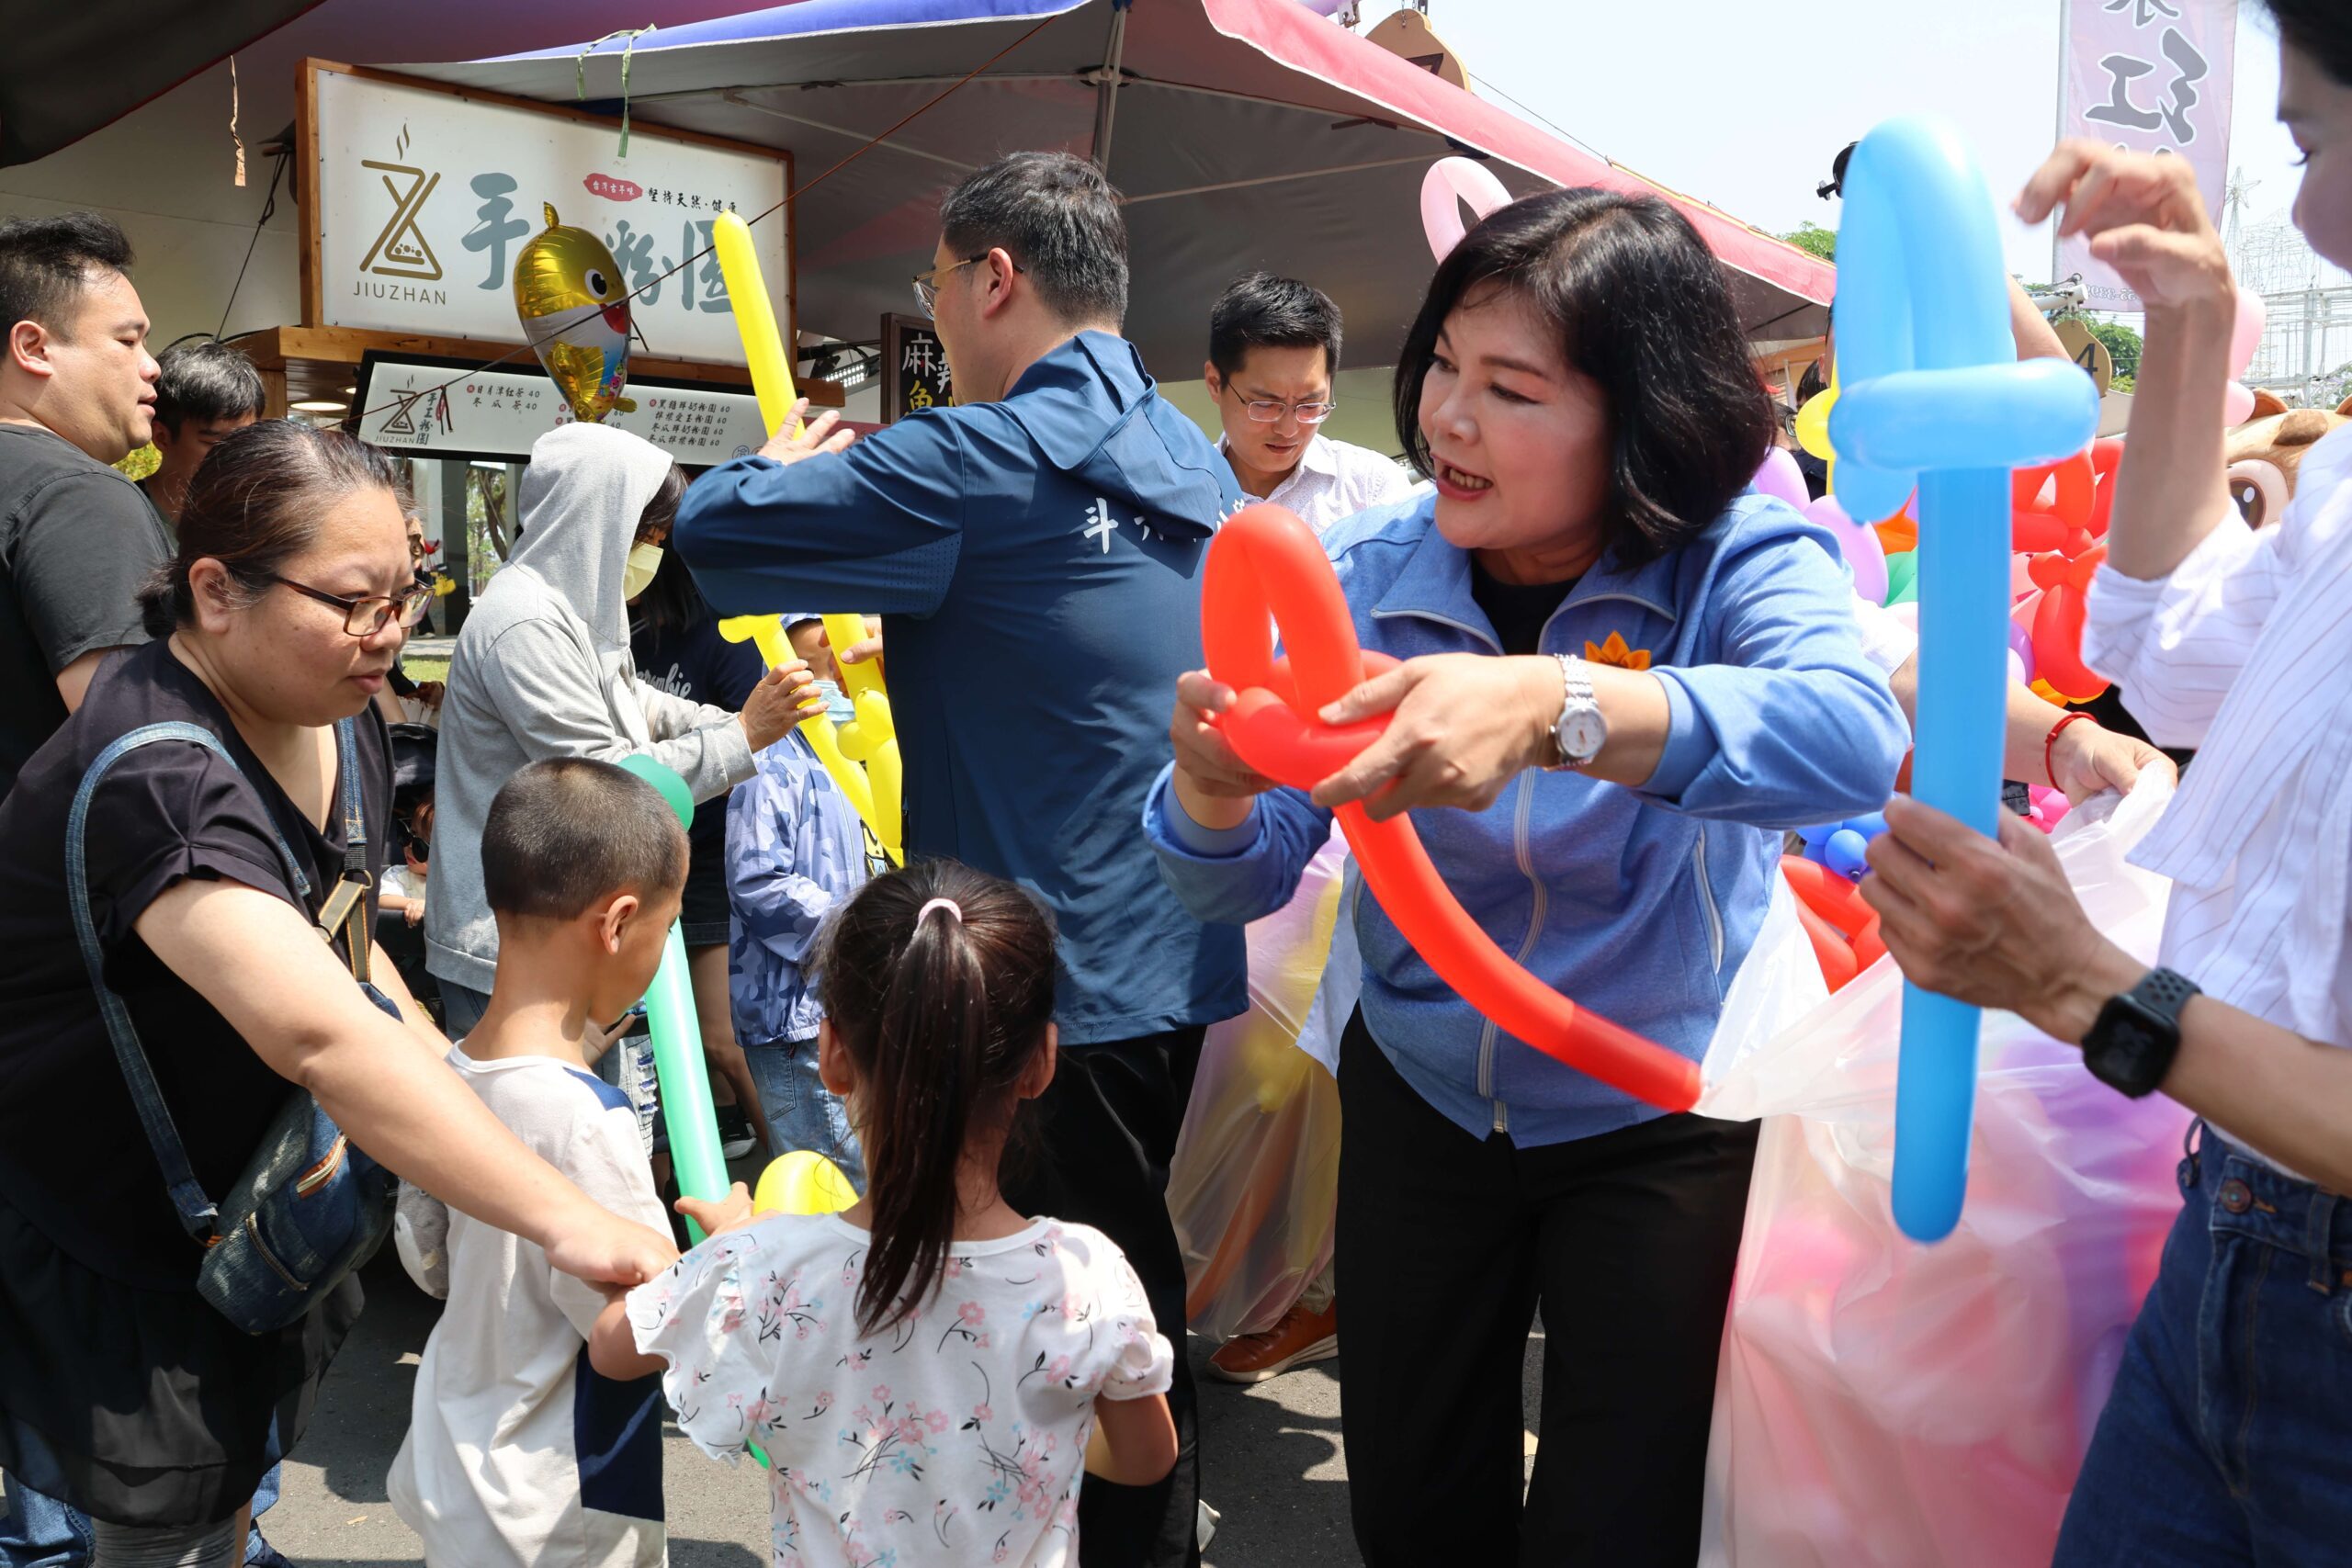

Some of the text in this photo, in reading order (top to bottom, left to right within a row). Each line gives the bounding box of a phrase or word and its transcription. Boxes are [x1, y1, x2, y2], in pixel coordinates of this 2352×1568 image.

[593, 180, 635, 196] 台灣古早味
[461, 172, 734, 315] 手粉圓
[353, 281, 446, 305] JIUZHAN
[2074, 343, 2098, 379] 4
[477, 384, 524, 398] 日月潭紅茶
[416, 392, 436, 445] 手工粉圓
[720, 405, 730, 413] 60
[375, 435, 415, 445] JIUZHAN
